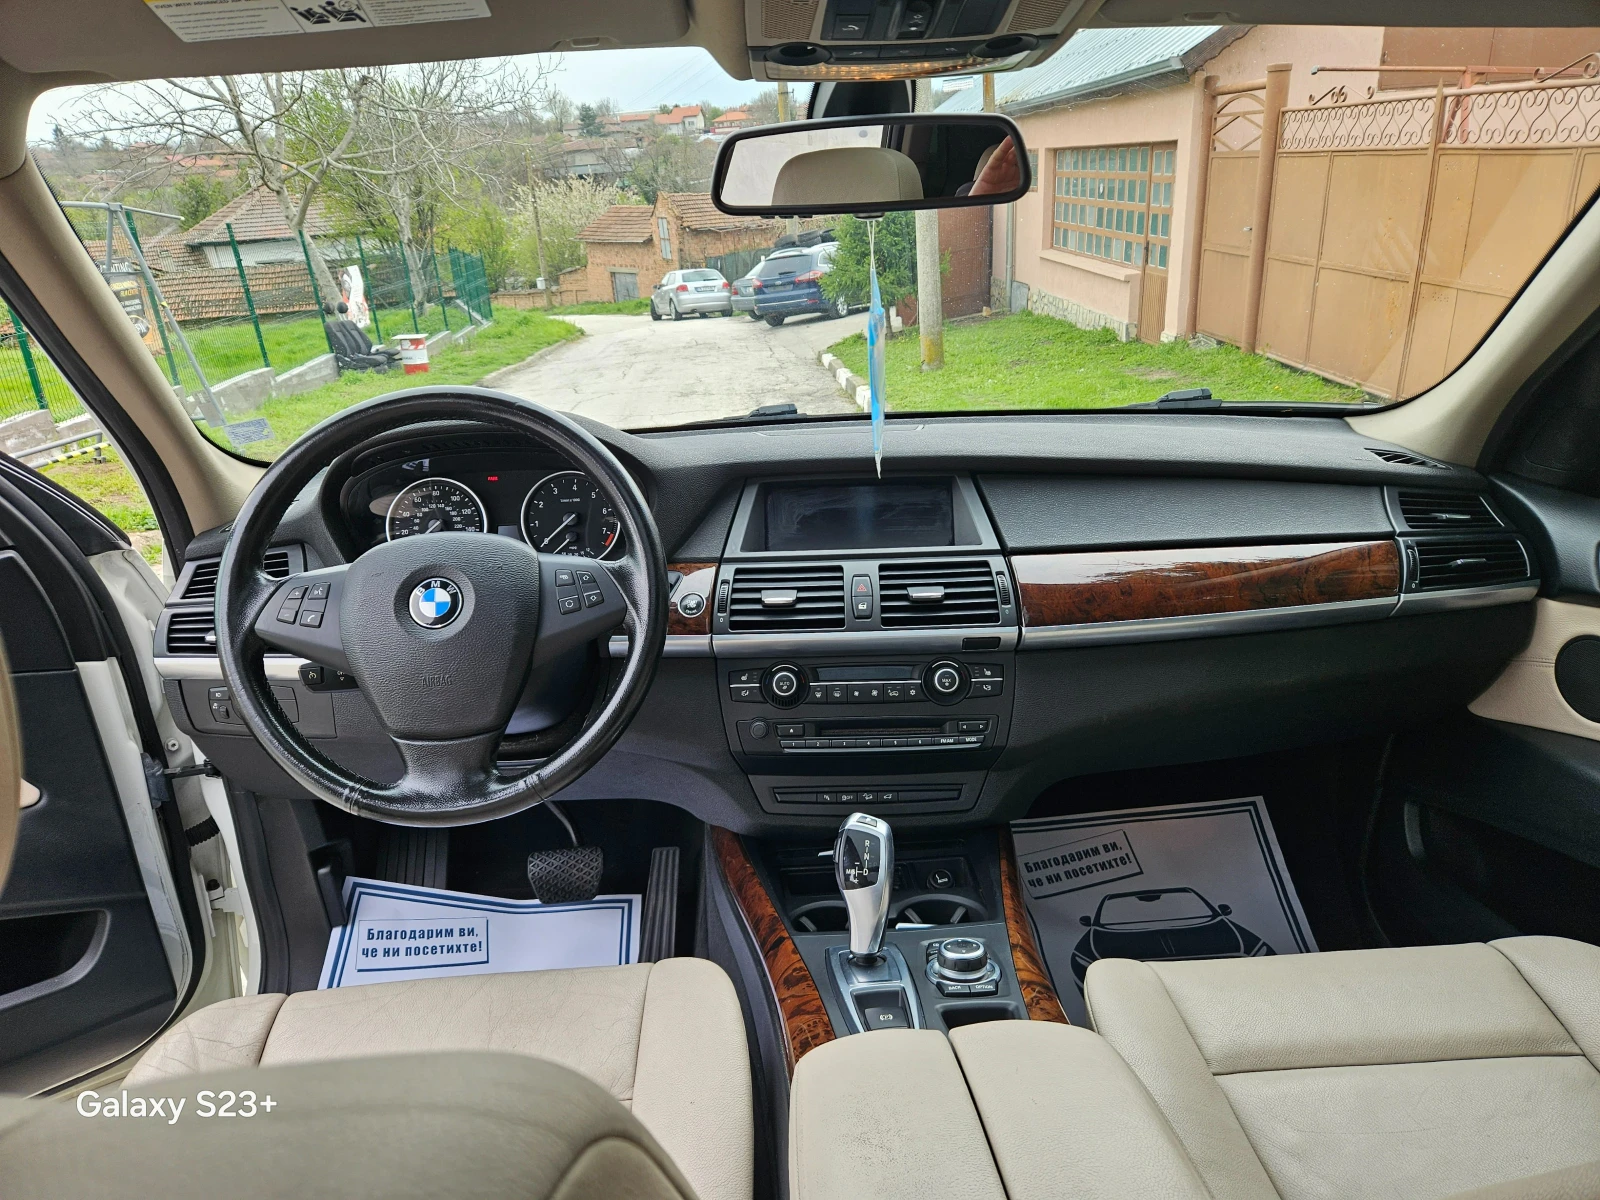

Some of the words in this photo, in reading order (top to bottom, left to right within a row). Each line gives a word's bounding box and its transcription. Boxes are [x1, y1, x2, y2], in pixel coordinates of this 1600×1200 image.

[552, 487, 558, 495] 3
[591, 491, 597, 499] 5
[602, 507, 608, 515] 6
[534, 520, 539, 528] 1
[602, 527, 608, 535] 7
[416, 581, 457, 596] BMW
[421, 675, 453, 688] AIRBAG
[864, 839, 870, 847] R
[863, 852, 870, 861] N
[1023, 846, 1101, 873] Благодарим
[1101, 841, 1123, 854] ви,
[862, 868, 869, 876] D
[1027, 876, 1044, 888] че
[1045, 871, 1063, 885] ни
[1063, 852, 1132, 880] посетихте!
[366, 928, 454, 941] Благодарим
[458, 927, 479, 938] ви,
[361, 947, 378, 958] че
[382, 947, 400, 957] ни
[404, 941, 482, 956] посетихте!
